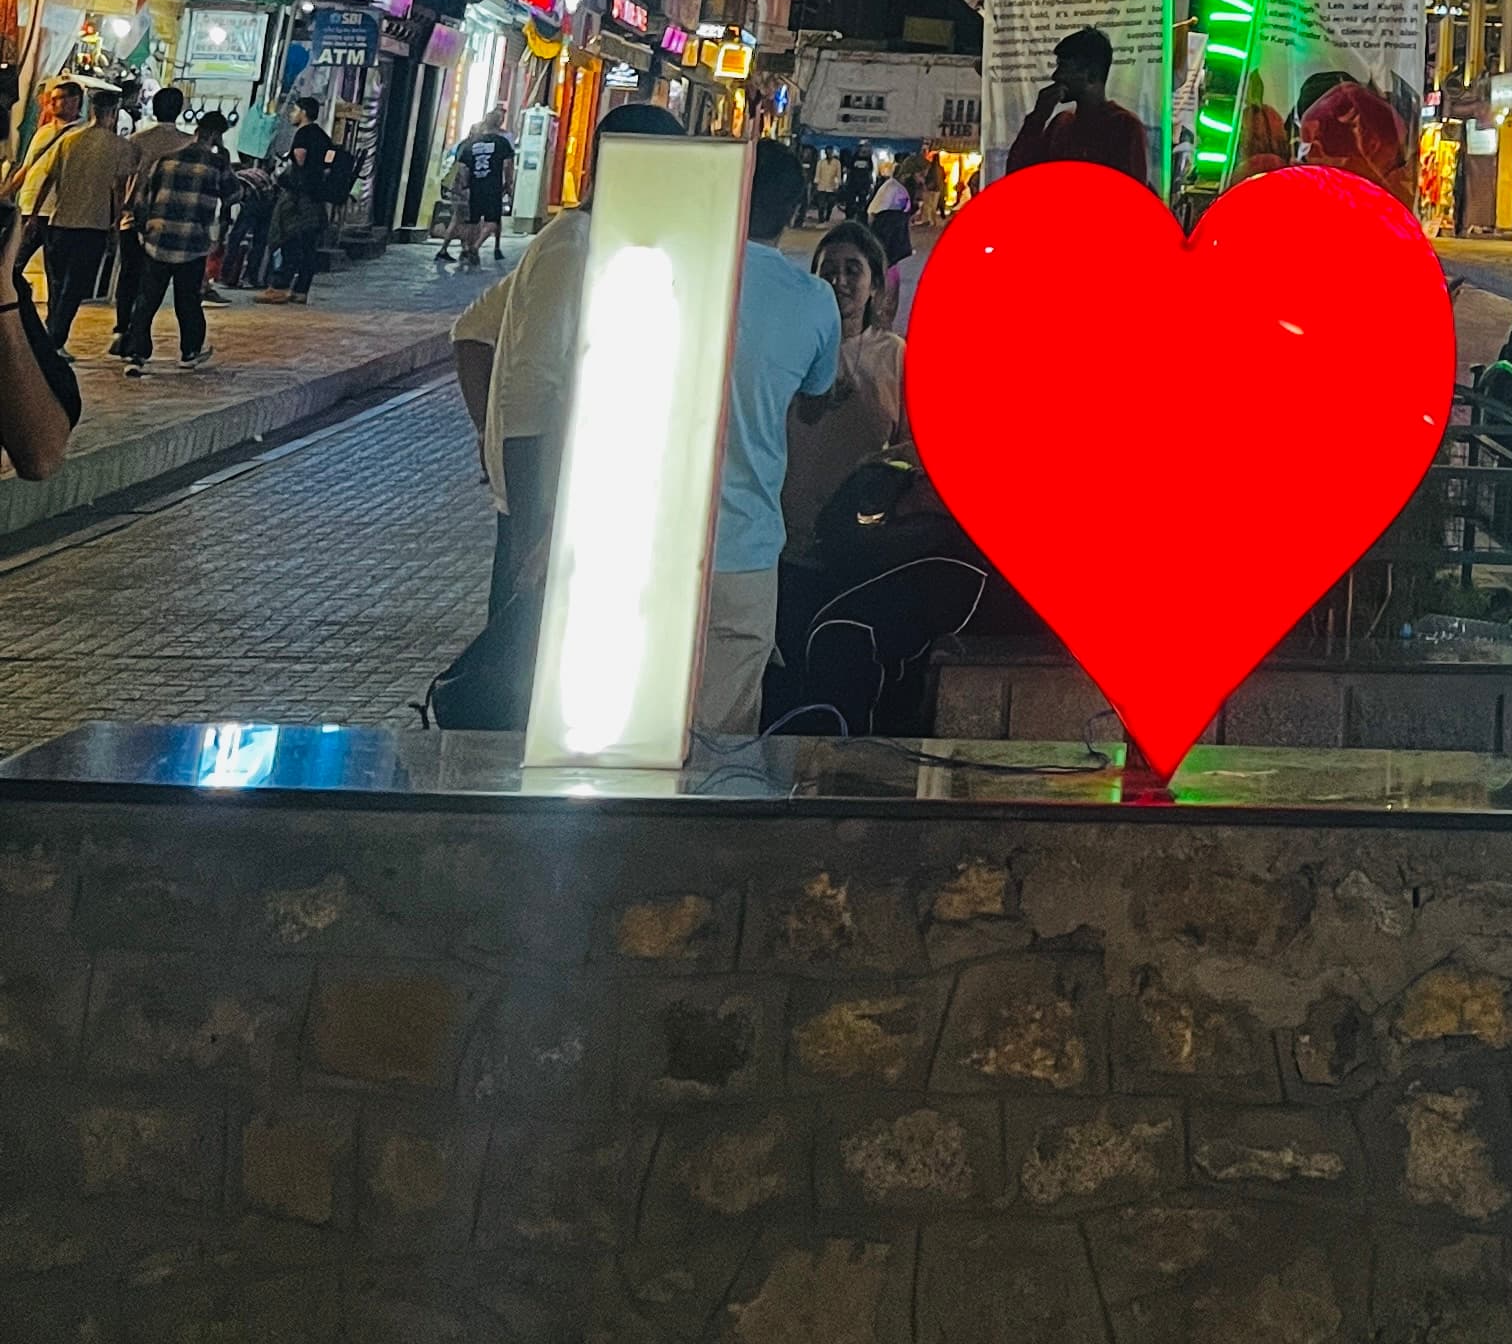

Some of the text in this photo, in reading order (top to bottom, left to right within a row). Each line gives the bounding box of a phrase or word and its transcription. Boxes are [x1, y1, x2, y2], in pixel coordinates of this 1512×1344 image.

[341, 13, 363, 25] SBI
[318, 49, 365, 65] ATM
[939, 123, 973, 137] THE
